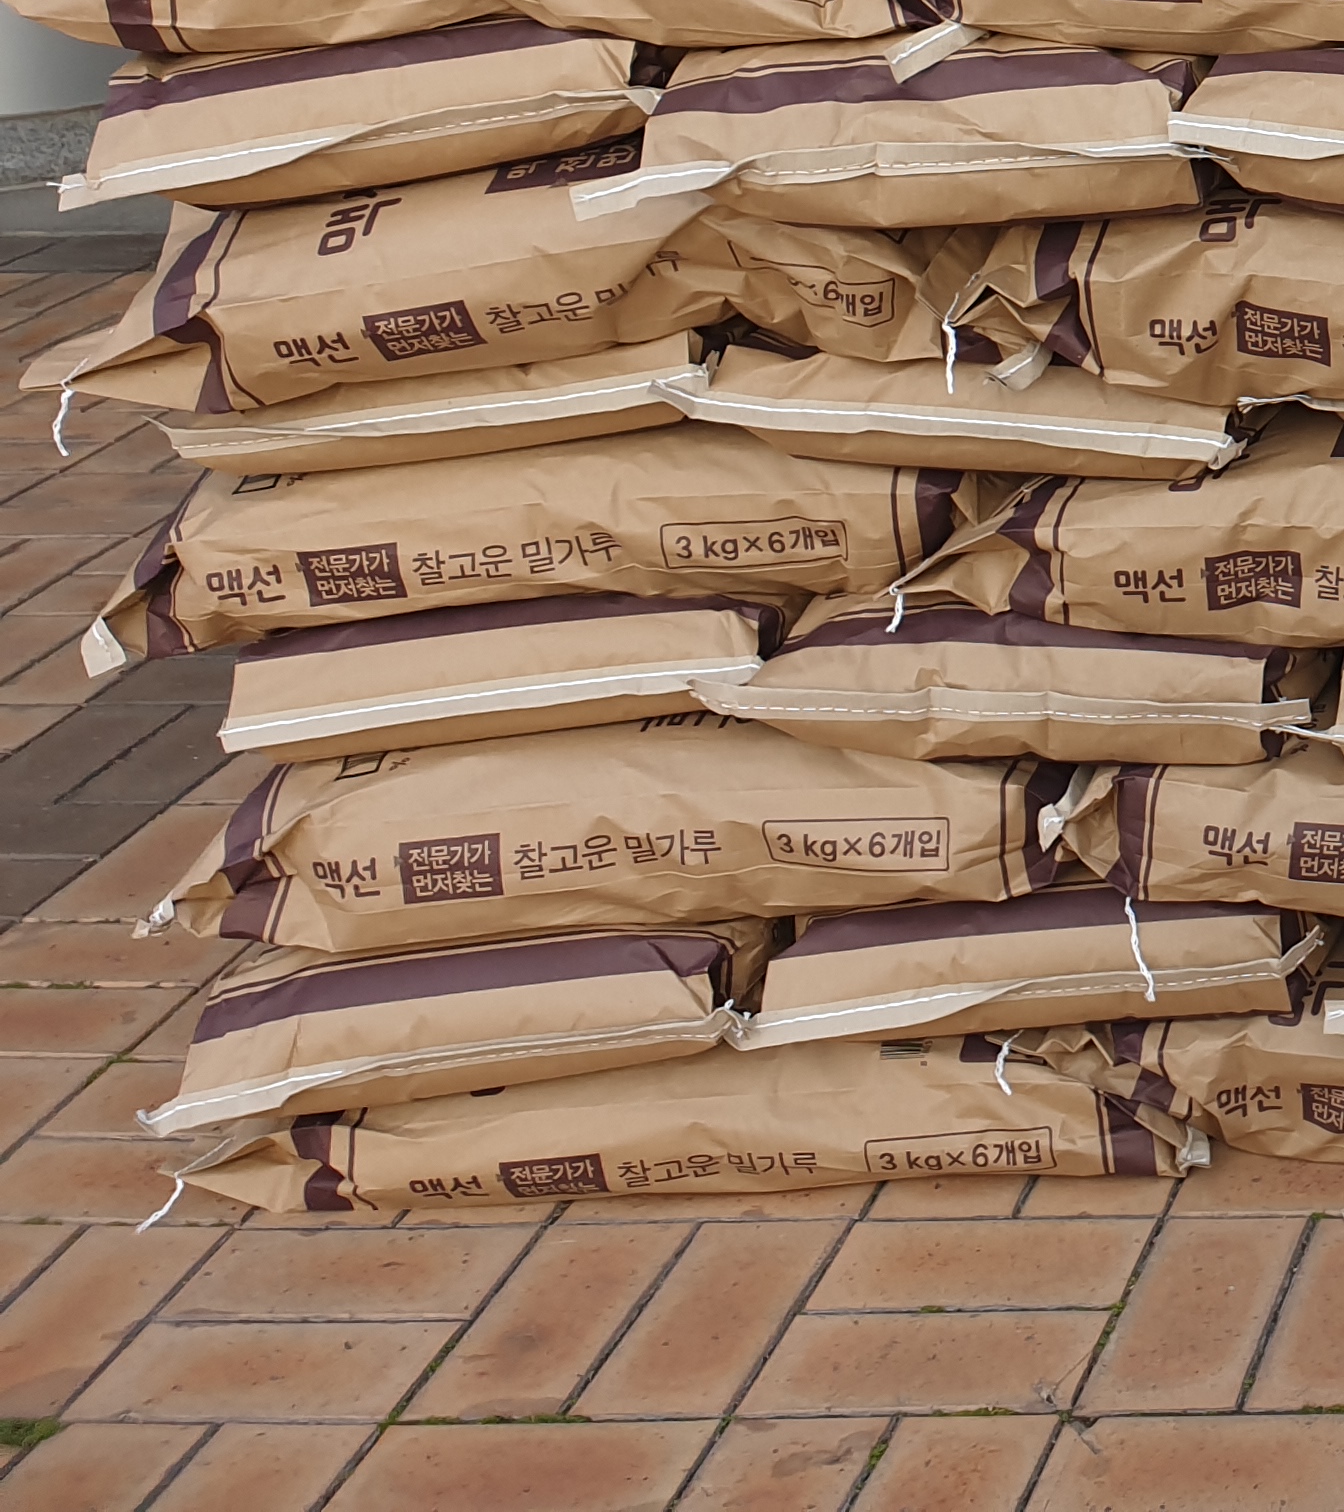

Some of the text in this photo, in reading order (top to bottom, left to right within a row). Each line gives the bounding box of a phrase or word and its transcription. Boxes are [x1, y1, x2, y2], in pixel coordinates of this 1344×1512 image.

[373, 305, 464, 337] 전문가가
[485, 290, 596, 336] 찰고운
[1244, 307, 1321, 342] 전문가가
[273, 329, 361, 369] 맥선
[1148, 316, 1219, 357] 맥선
[1245, 330, 1326, 361] 먼저찾는
[309, 550, 391, 576] 전문가가
[411, 546, 511, 588] 찰고운
[1213, 554, 1296, 581] 전문가가
[206, 564, 286, 605] 맥선
[316, 573, 397, 600] 먼저찾는
[1113, 567, 1188, 603] 맥선
[1216, 577, 1296, 604] 먼저찾는
[408, 841, 492, 871] 전문가가
[513, 829, 722, 880] 찰고운 밀가루
[1201, 823, 1272, 867] 맥선
[312, 859, 382, 900] 맥선
[411, 869, 494, 897] 먼저찾는
[1215, 1085, 1283, 1118] 맥선
[409, 1173, 490, 1202] 맥선
[508, 1158, 596, 1183] 전문가가
[616, 1153, 721, 1189] 찰고운
